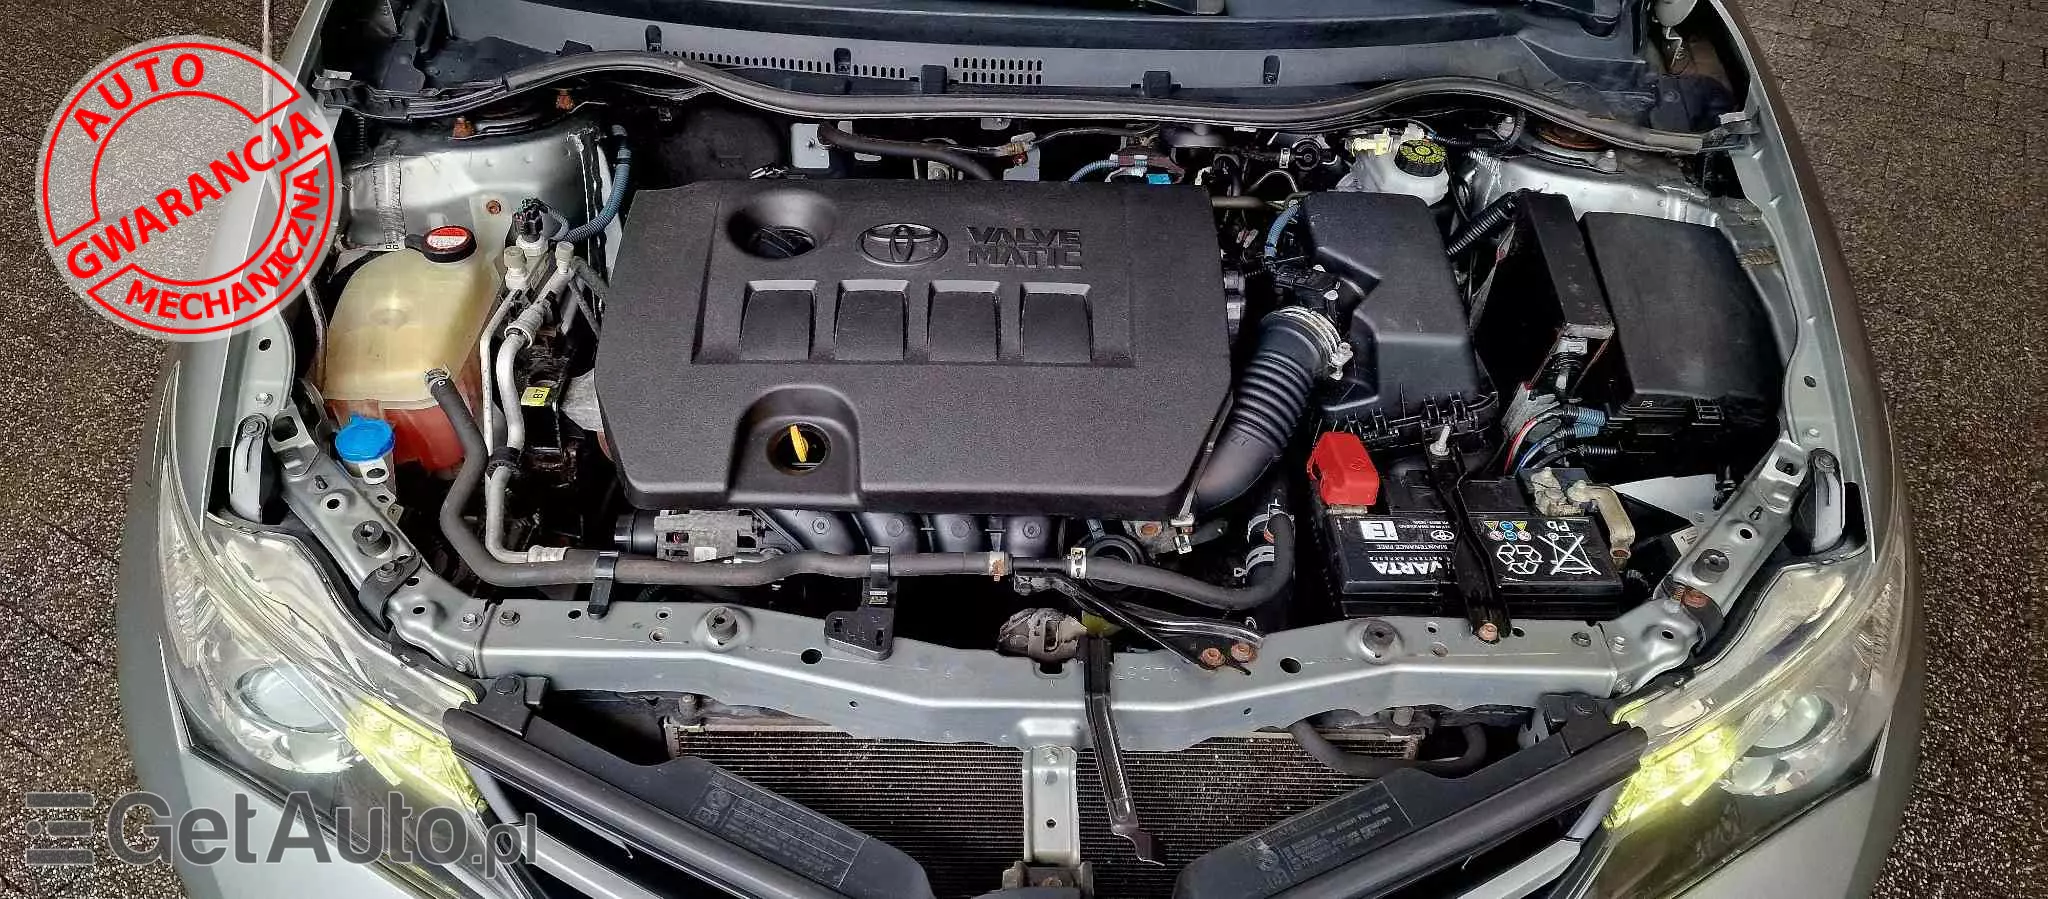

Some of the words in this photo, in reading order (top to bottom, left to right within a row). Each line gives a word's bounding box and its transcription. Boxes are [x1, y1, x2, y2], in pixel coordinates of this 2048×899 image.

[966, 226, 1081, 249] VALVE
[967, 248, 1082, 270] MATIC
[1546, 521, 1570, 532] Pb
[1369, 561, 1444, 576] VARTA
